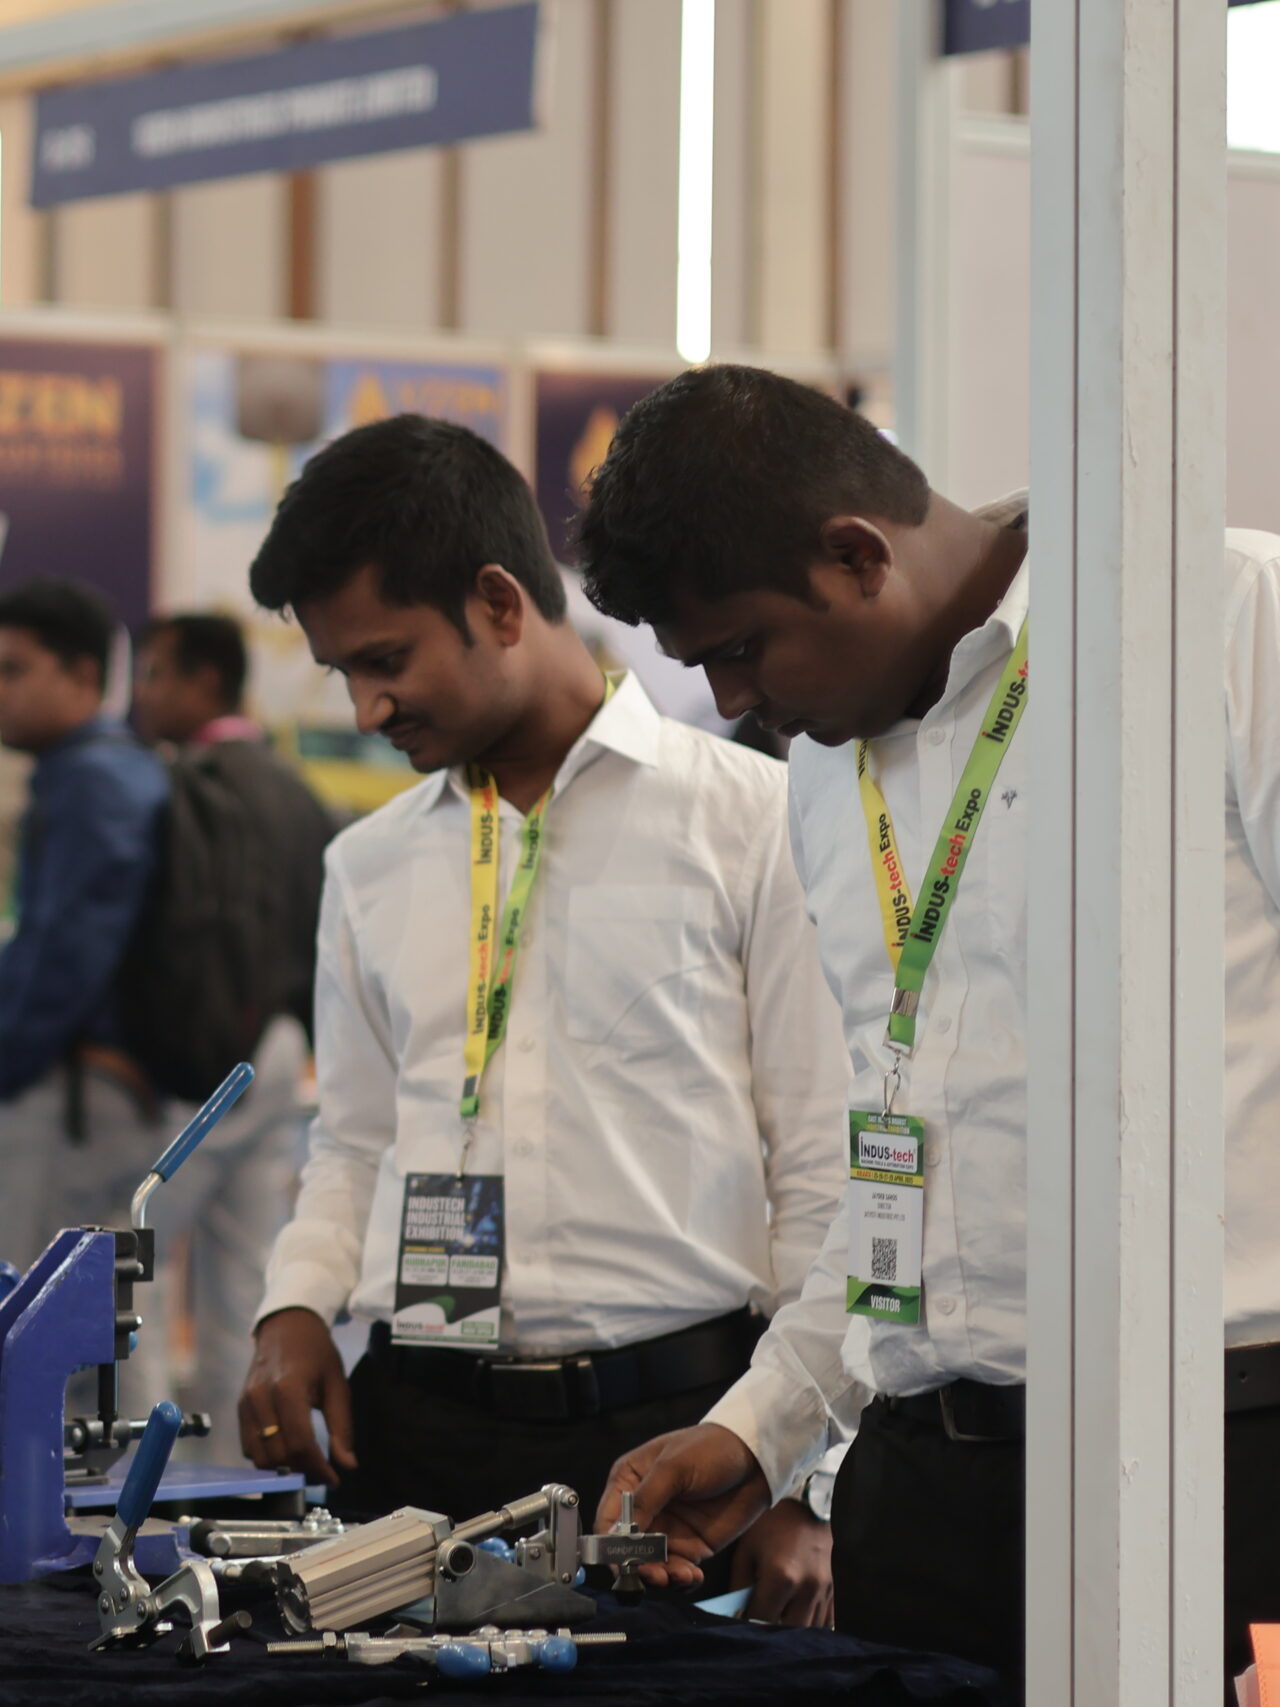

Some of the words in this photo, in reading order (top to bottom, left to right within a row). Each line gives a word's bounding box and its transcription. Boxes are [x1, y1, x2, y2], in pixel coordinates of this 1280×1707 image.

[955, 788, 982, 832] Expo
[879, 813, 891, 852] Expo
[478, 904, 491, 941] Expo
[505, 907, 520, 945] Expo
[407, 1196, 466, 1211] INDUSTECH
[404, 1224, 465, 1241] EXHIBITION
[406, 1211, 466, 1226] INDUSTRIAL
[870, 1294, 901, 1313] VISITOR
